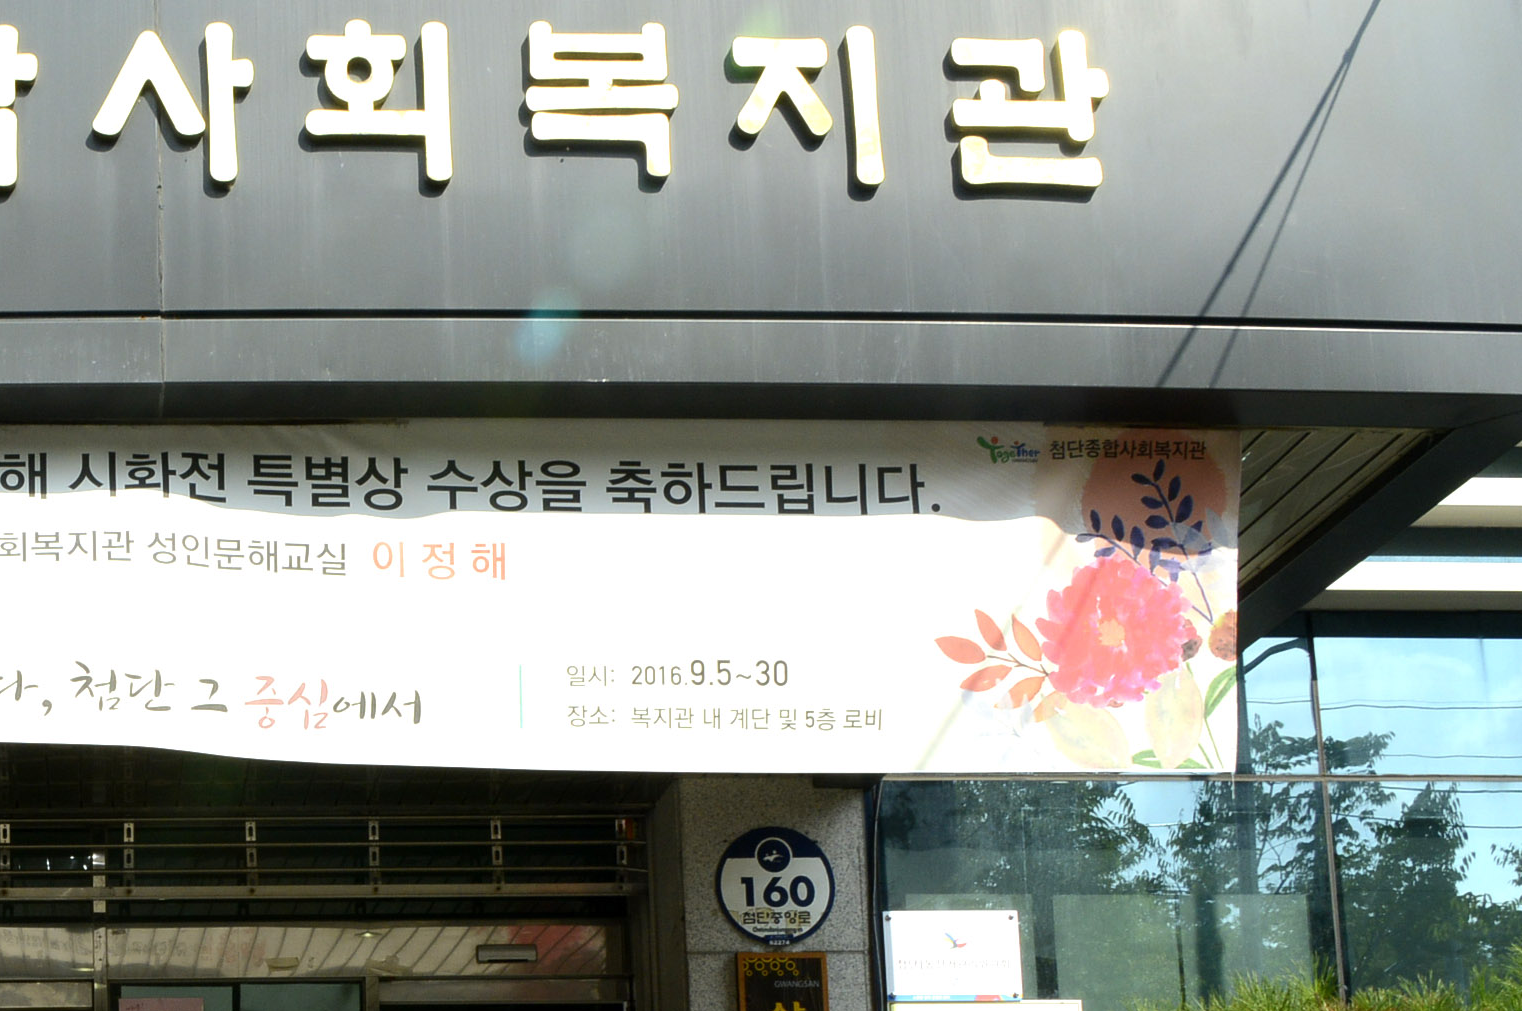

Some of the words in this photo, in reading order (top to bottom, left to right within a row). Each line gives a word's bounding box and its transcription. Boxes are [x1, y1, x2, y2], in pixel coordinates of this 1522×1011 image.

[1049, 439, 1207, 460] 첨단종합사회복지관
[68, 451, 228, 503] 시화전
[246, 453, 409, 511] 특별상
[426, 458, 587, 513] 수상을
[604, 459, 942, 515] 축하드립니다.
[147, 532, 347, 577] 성인문해교실
[566, 664, 615, 687] 일시:
[630, 659, 789, 687] 2016.9.5~30
[68, 660, 176, 713] 첨단
[189, 677, 230, 714] 그
[243, 675, 423, 731] 중심에서
[566, 704, 616, 728] 장소:
[631, 706, 695, 730] 복지관
[702, 706, 722, 730] 내
[729, 706, 772, 731] 계단
[778, 707, 798, 732] 및
[804, 708, 837, 732] 5층
[842, 708, 884, 732] 로비
[740, 875, 816, 907] 160
[742, 910, 812, 925] 첨단중앙로
[774, 980, 820, 988] GWANGSAN
